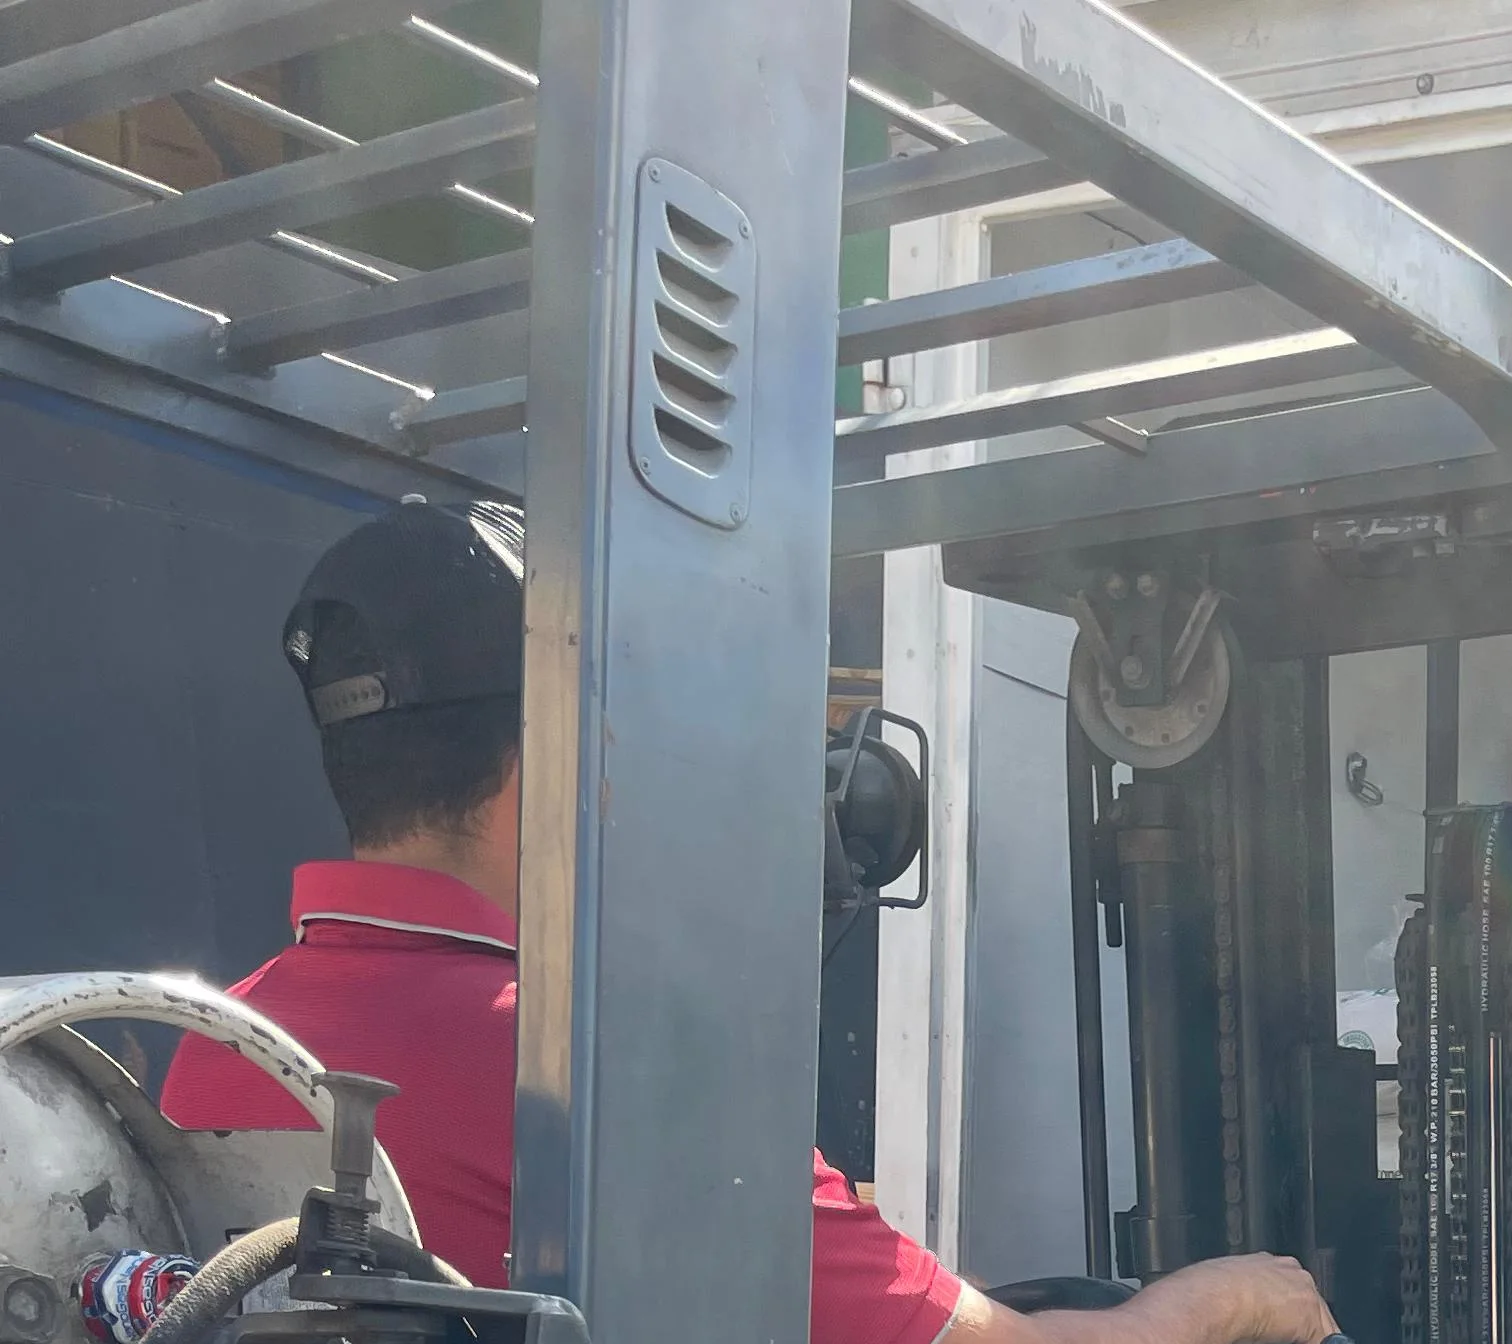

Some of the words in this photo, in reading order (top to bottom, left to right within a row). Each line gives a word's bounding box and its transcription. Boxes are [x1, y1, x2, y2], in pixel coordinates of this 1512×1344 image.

[1482, 908, 1490, 942] HOSE
[1480, 944, 1489, 1012] HYDRAULIC
[1430, 1172, 1438, 1192] R17
[1430, 1275, 1439, 1340] HYDRAULIC
